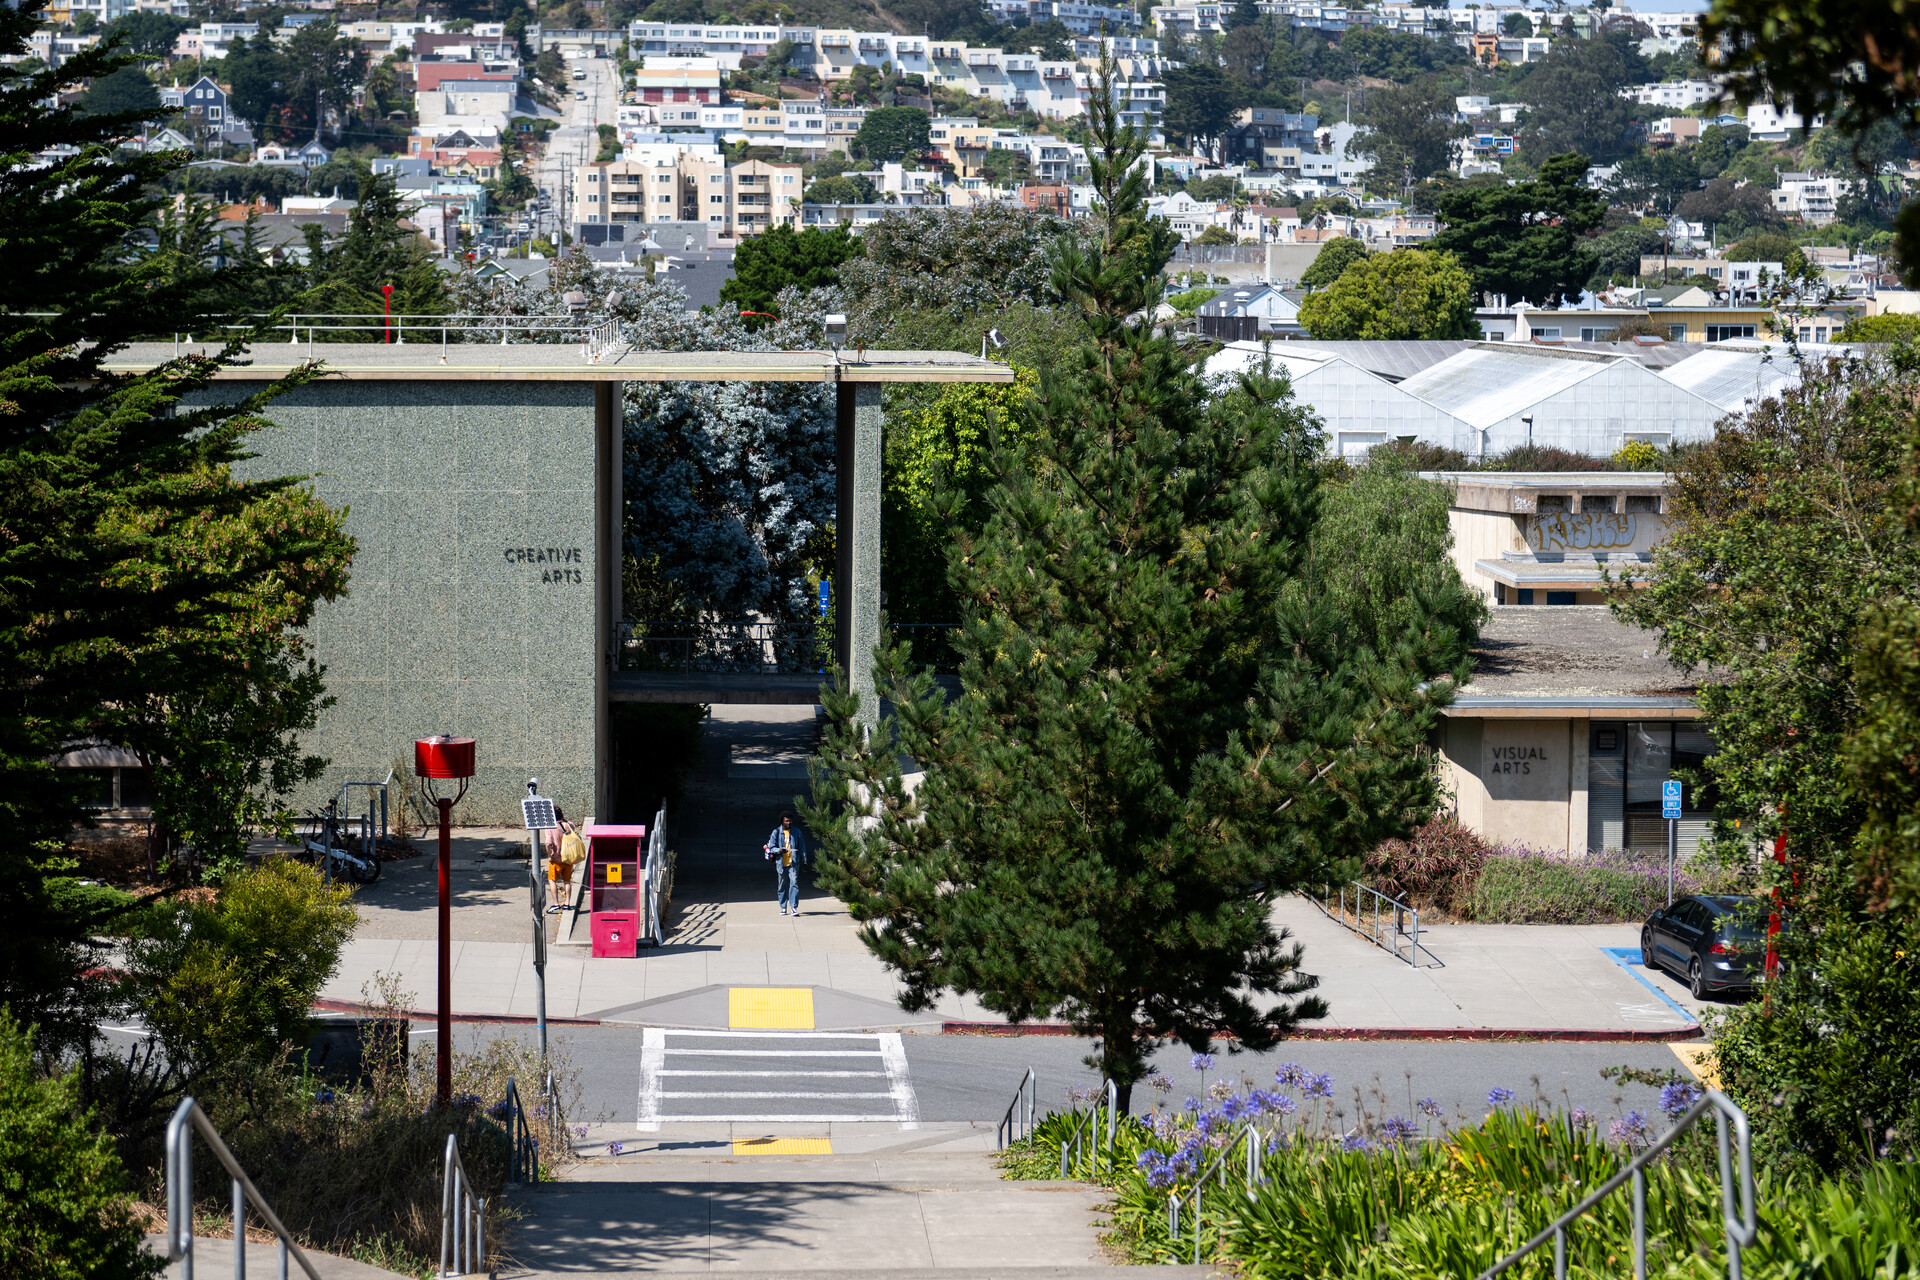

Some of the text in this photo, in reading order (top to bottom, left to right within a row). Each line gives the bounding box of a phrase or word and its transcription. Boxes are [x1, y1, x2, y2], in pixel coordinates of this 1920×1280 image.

[504, 548, 581, 563] CREATIVE
[542, 569, 582, 584] ARTS
[1492, 746, 1547, 760] VISUAL
[1492, 761, 1530, 775] ARTS
